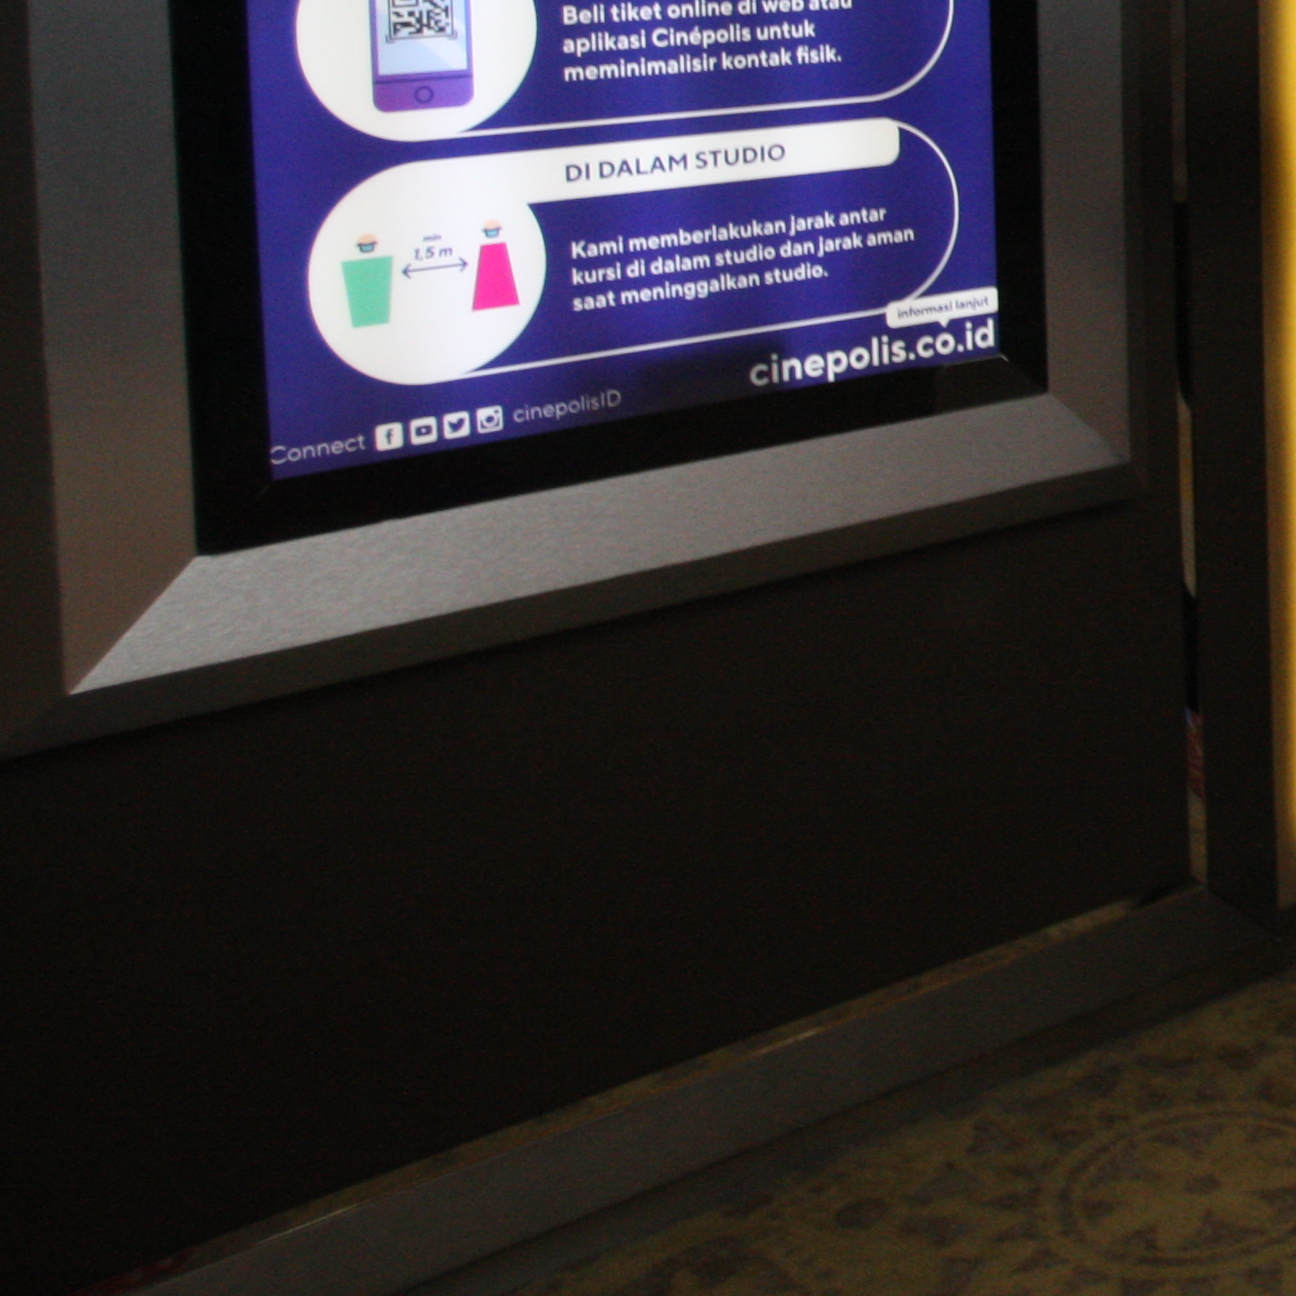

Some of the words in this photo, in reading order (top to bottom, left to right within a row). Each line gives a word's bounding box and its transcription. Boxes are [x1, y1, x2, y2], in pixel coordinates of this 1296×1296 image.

[563, 5, 605, 25] Beli
[610, 3, 662, 23] tiket
[668, 0, 732, 19] online
[563, 28, 646, 56] aplikasi
[652, 23, 750, 49] Cinépolis
[756, 19, 815, 40] untuk
[564, 56, 717, 82] meminimalisir
[722, 49, 791, 70] kontak
[797, 46, 841, 64] fisik.
[566, 164, 590, 182] DI
[600, 154, 688, 178] DALAM
[695, 144, 785, 169] STUDIO
[572, 236, 623, 259] Kami
[629, 219, 786, 252] memberlakukan
[789, 213, 835, 236] jarak
[839, 207, 886, 225] antar
[572, 264, 621, 285] kursi
[627, 258, 646, 277] di
[651, 252, 710, 275] dalam
[715, 243, 775, 266] studio
[780, 238, 814, 257] dan
[817, 233, 863, 255] jarak
[867, 228, 914, 246] aman
[573, 292, 615, 312] saat
[620, 273, 760, 307] meninggalkan
[765, 264, 828, 285] studio.
[898, 302, 952, 318] informasi
[955, 297, 989, 310] lanjut
[750, 318, 994, 386] cinepolis.co.id
[270, 435, 366, 465] Connect
[513, 390, 621, 423] cinepolisID
